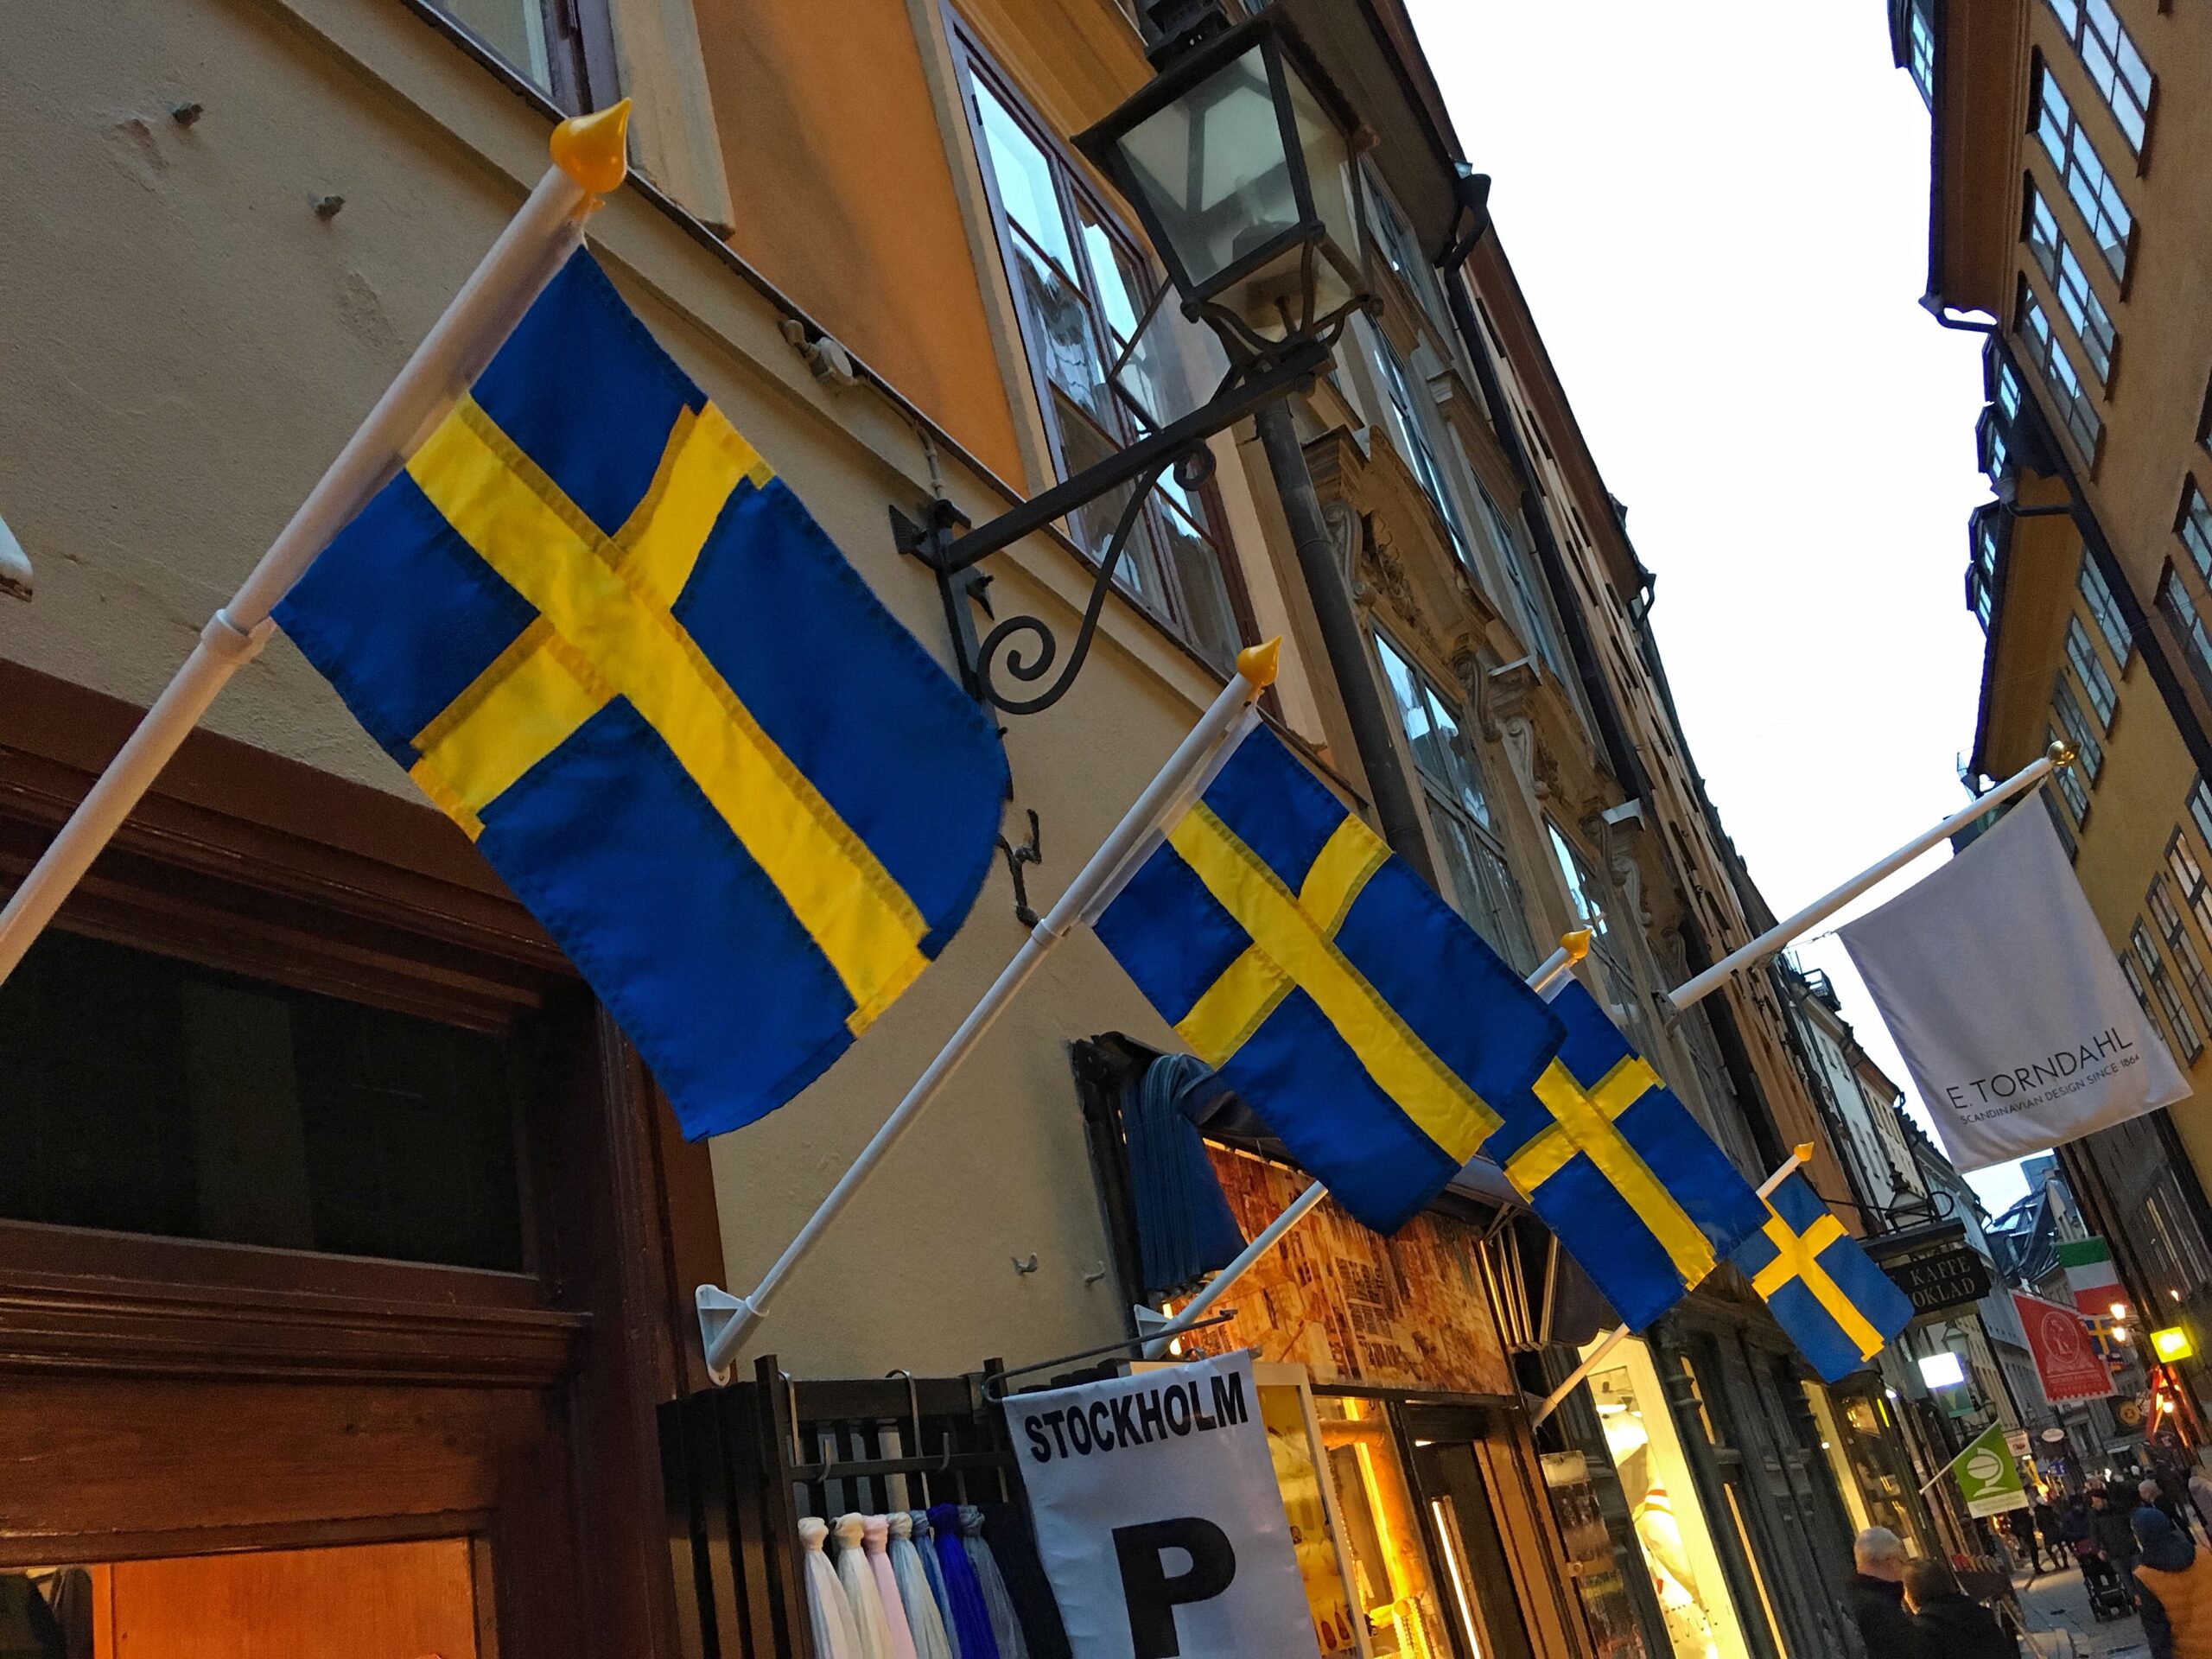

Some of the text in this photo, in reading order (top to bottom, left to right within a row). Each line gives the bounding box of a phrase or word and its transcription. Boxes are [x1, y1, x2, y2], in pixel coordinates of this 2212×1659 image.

[1960, 1095, 2044, 1125] SCANDINAVIAN
[2044, 1079, 2086, 1102] DESIGN
[2087, 1062, 2120, 1084] SINCE
[1910, 1255, 1972, 1287] KAFFE
[1911, 1277, 1976, 1307] OKLAD
[1024, 1371, 1249, 1463] STOCKHOLM
[1111, 1516, 1236, 1659] P
